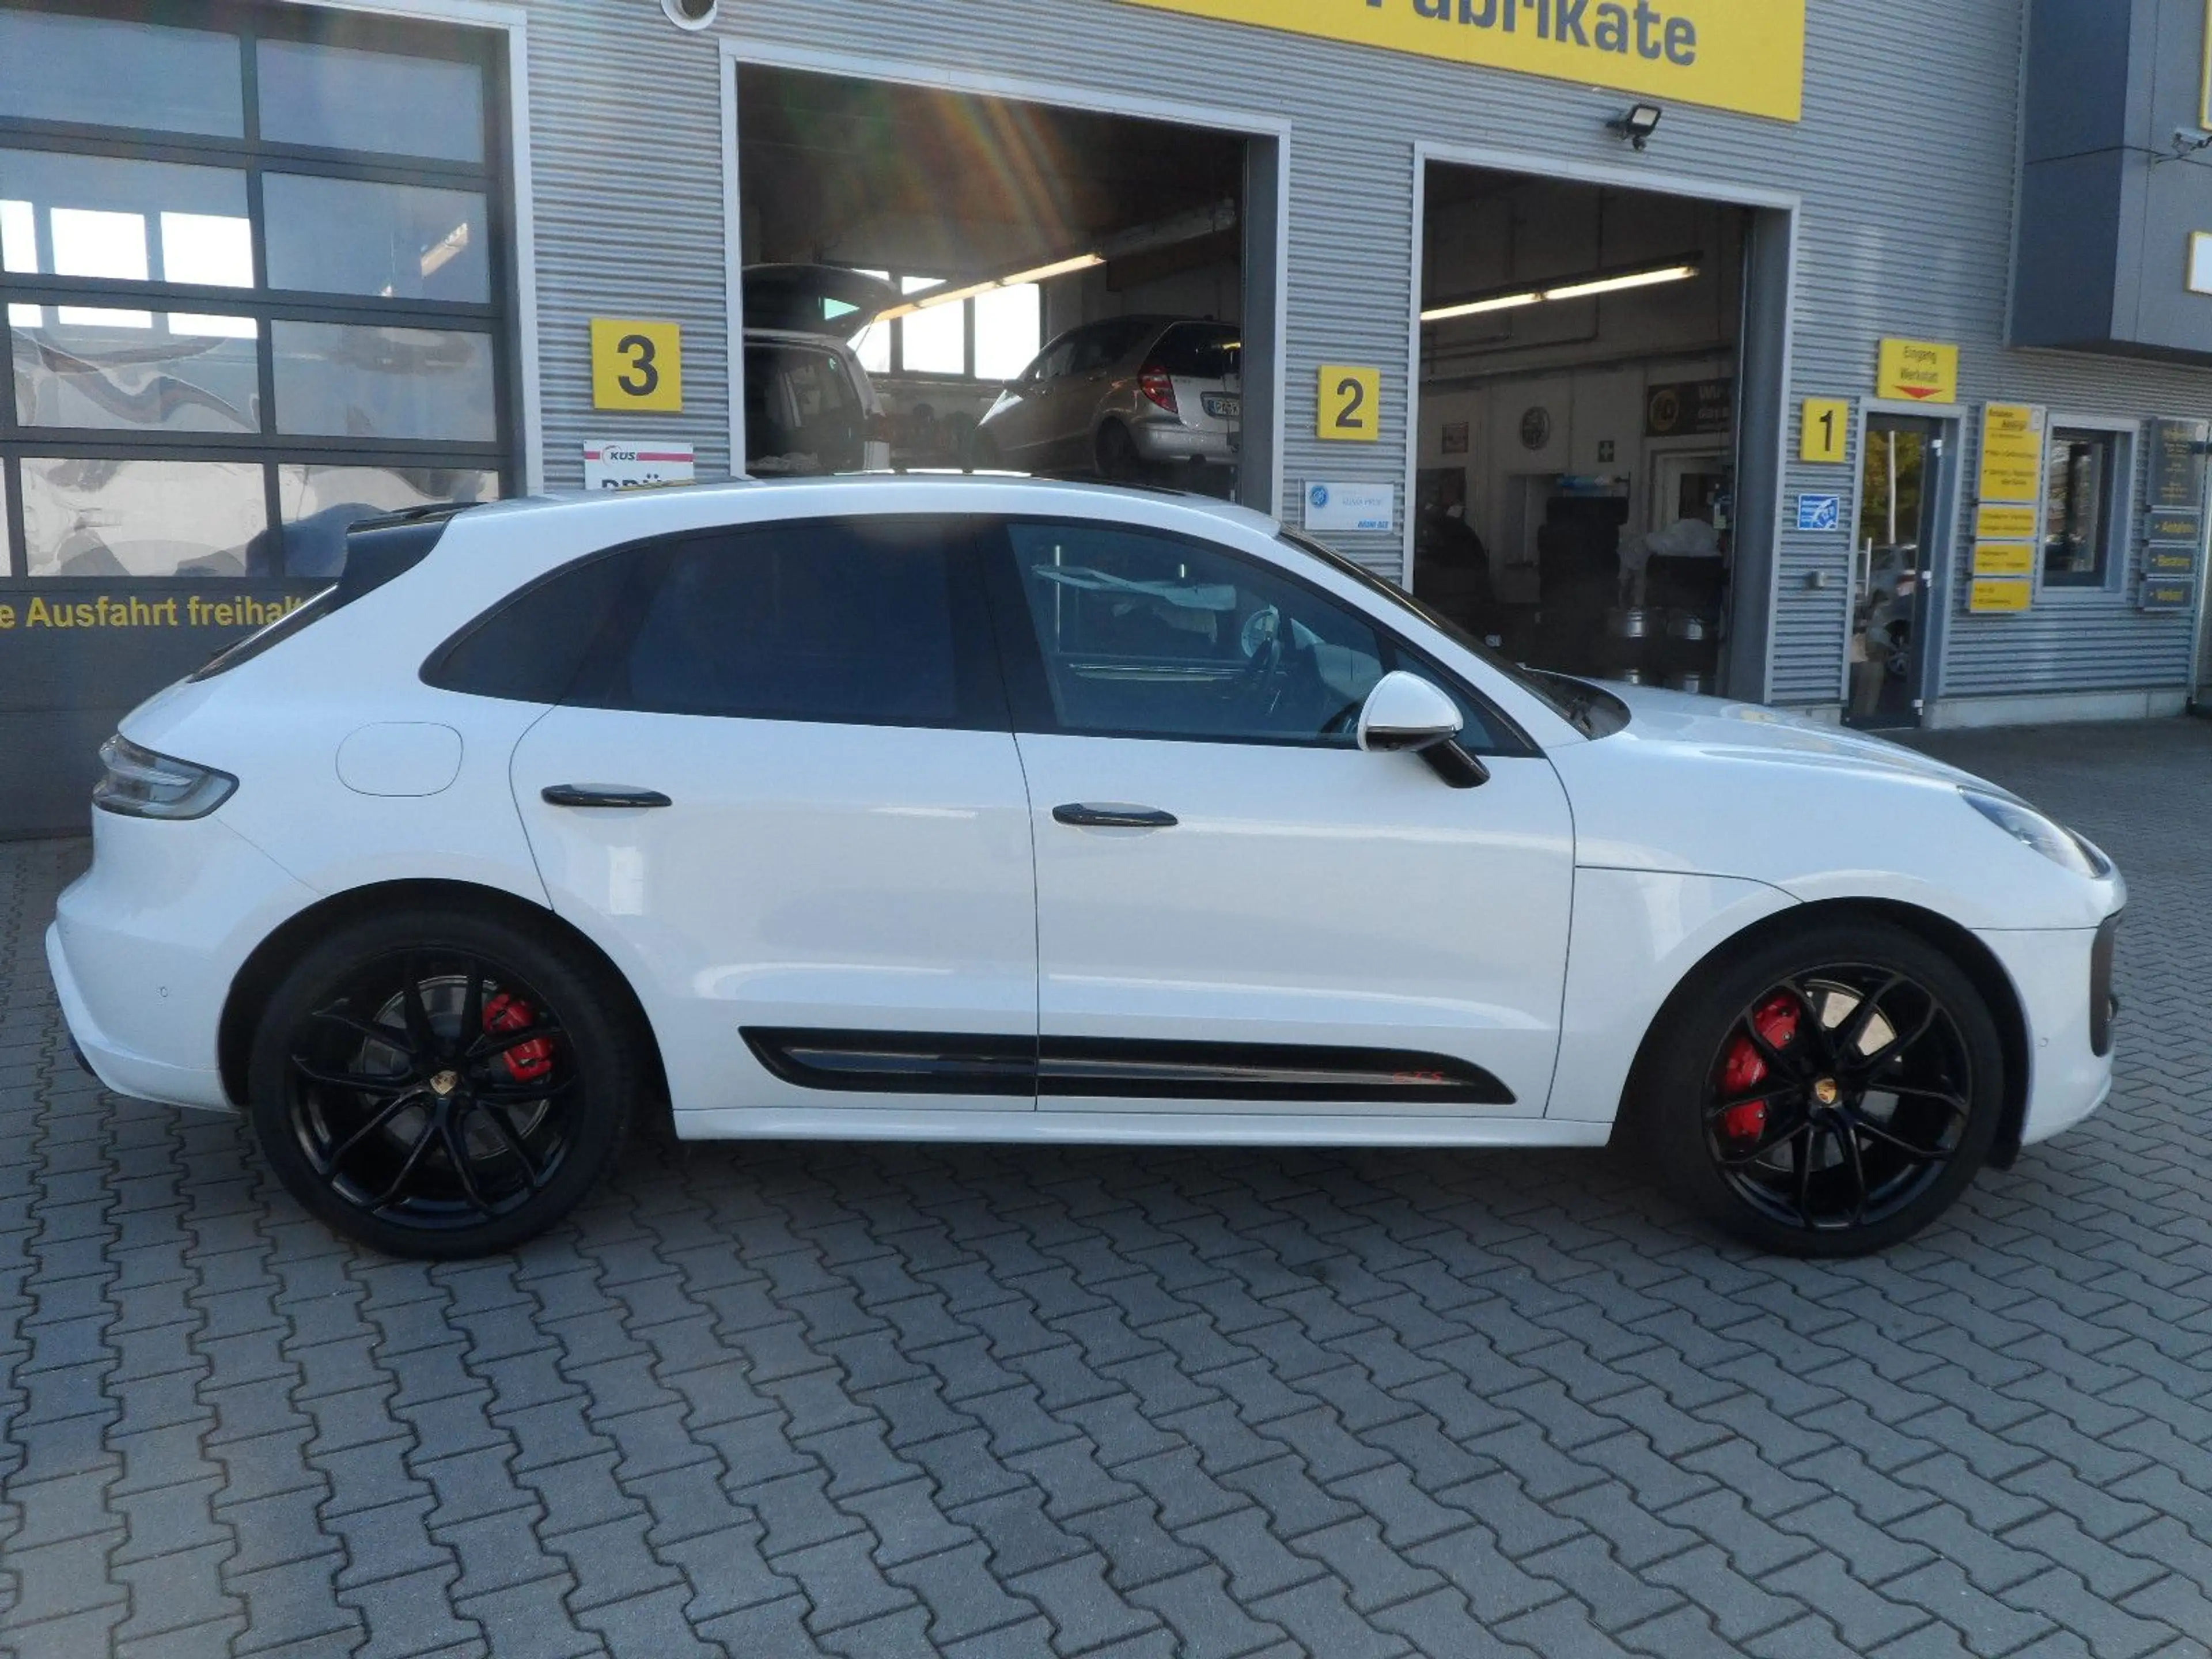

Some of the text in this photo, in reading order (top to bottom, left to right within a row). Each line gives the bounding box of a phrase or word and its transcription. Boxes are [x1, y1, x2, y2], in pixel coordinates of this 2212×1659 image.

[1366, 0, 1696, 66] abrikate
[617, 335, 658, 396] 3
[1335, 378, 1363, 427] 2
[1820, 410, 1832, 451] 1
[26, 597, 177, 627] Ausfahrt
